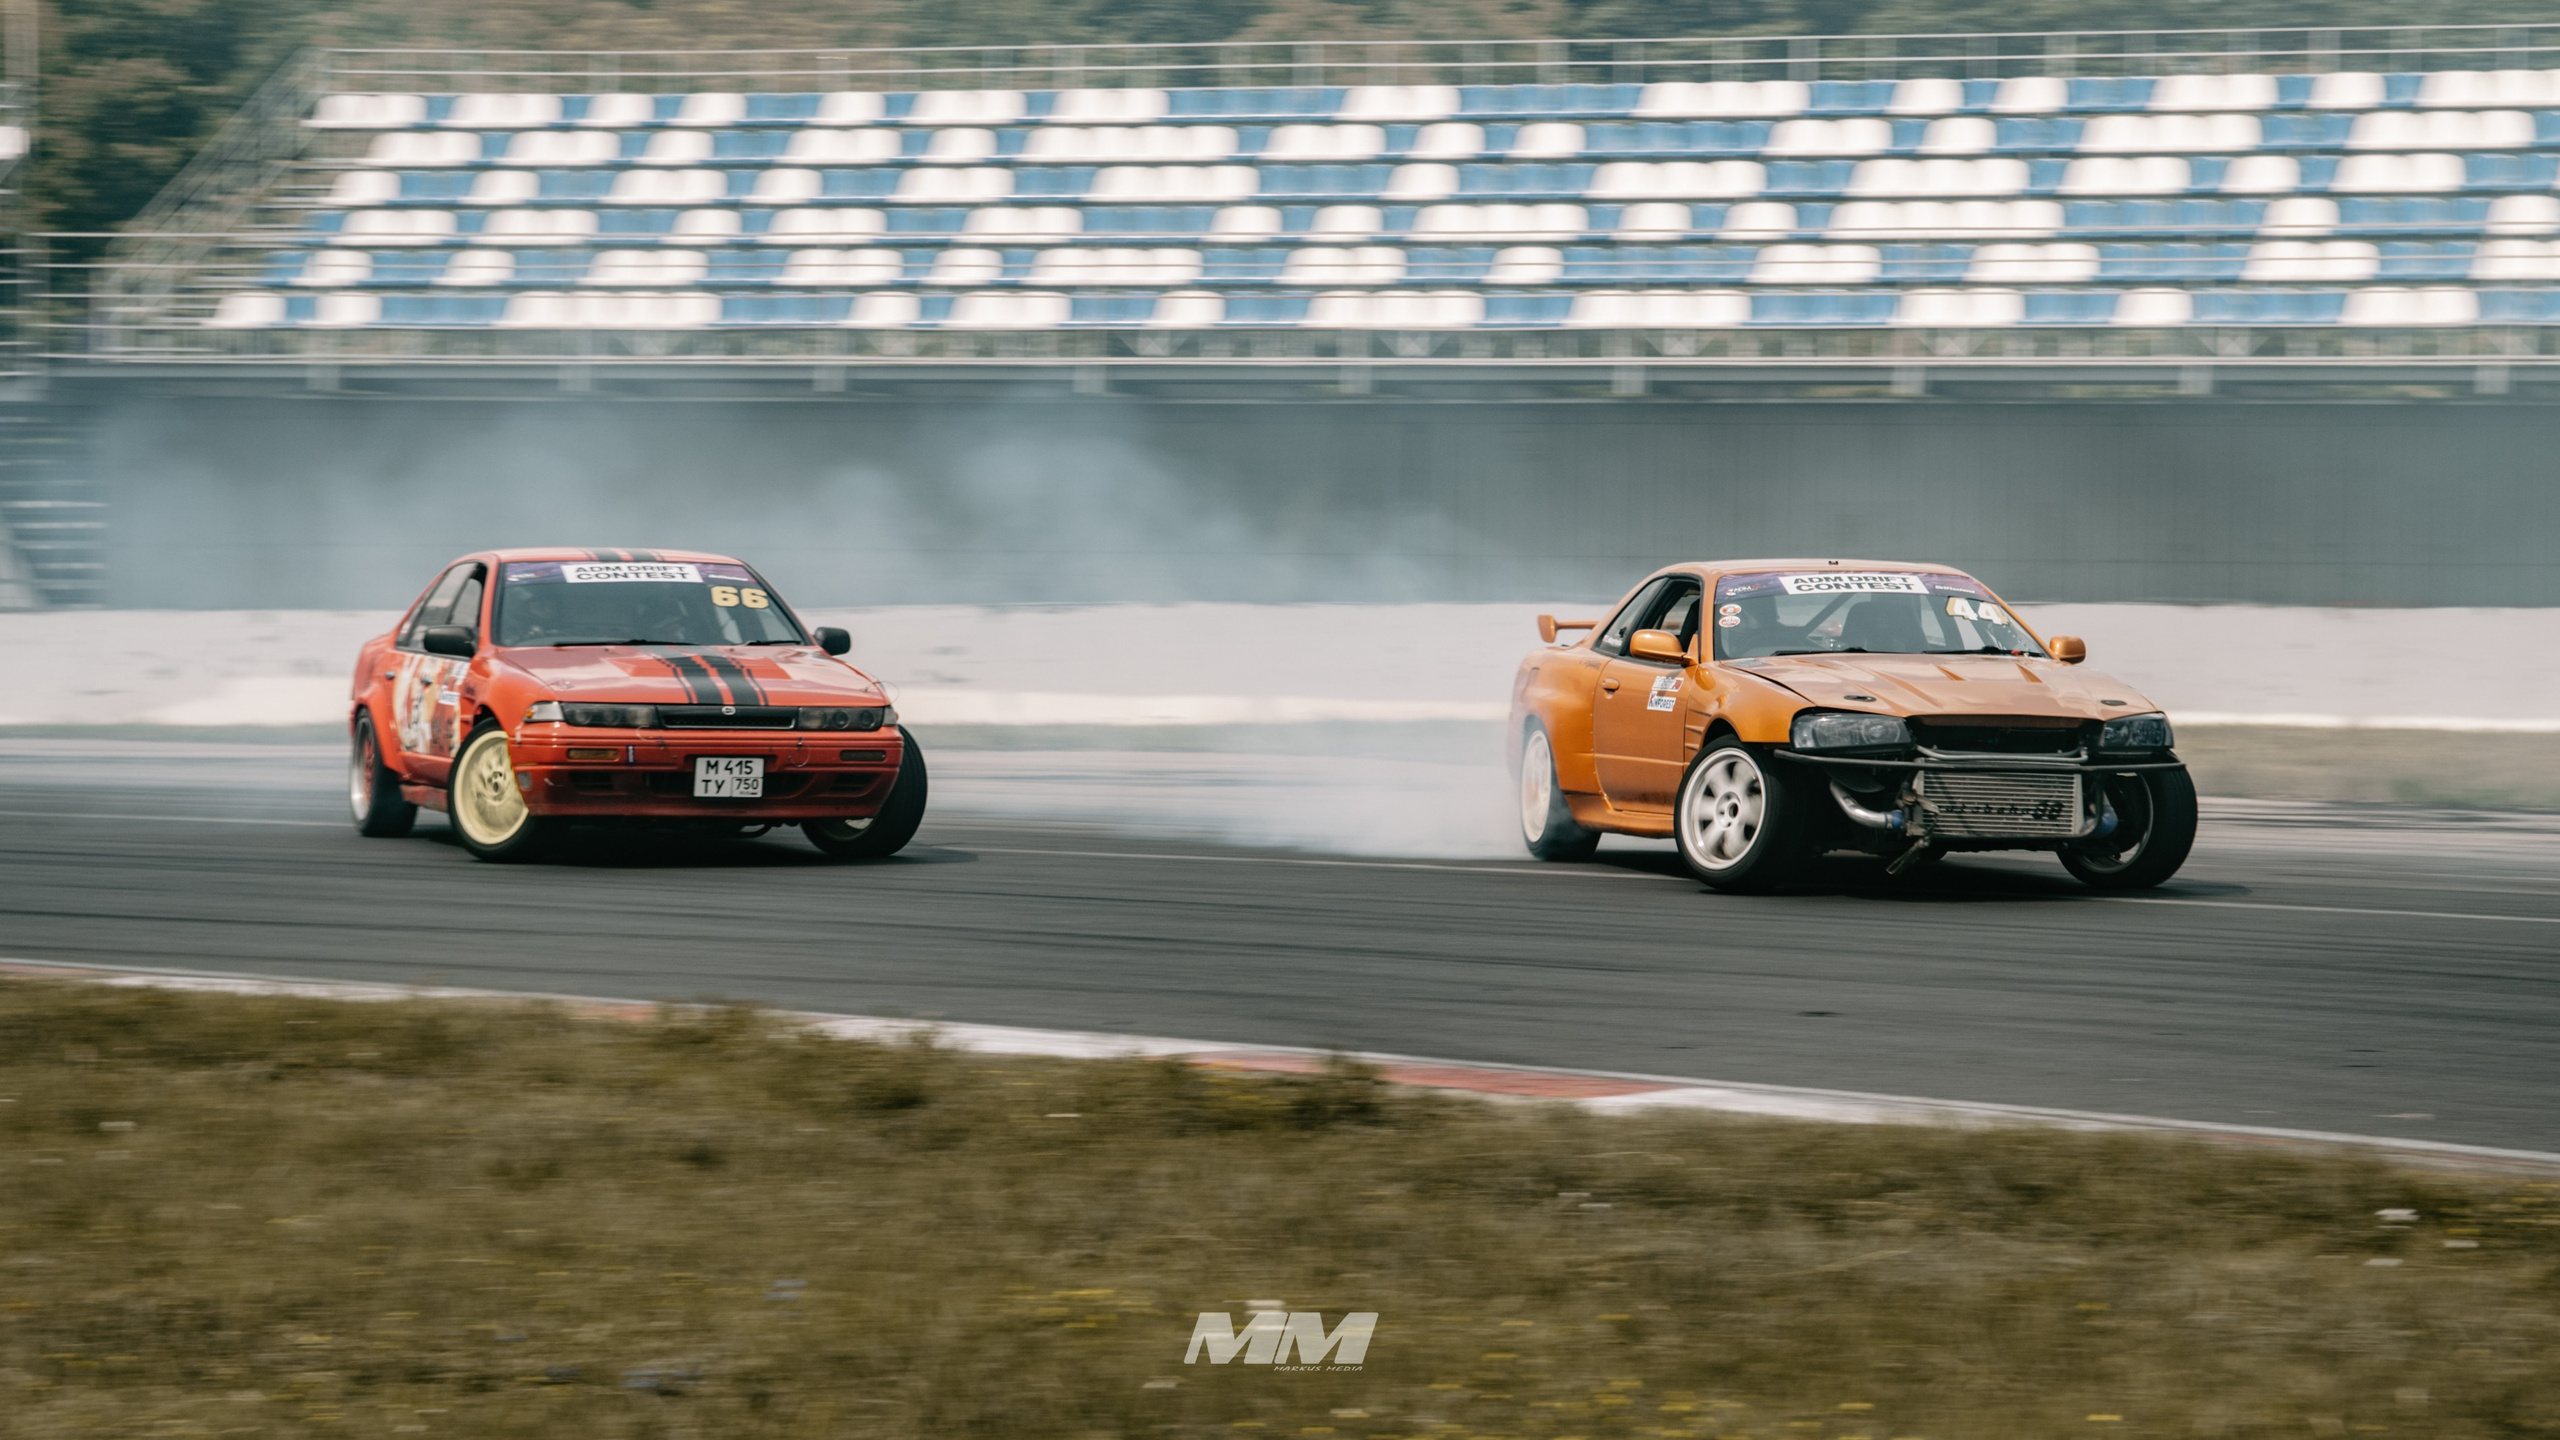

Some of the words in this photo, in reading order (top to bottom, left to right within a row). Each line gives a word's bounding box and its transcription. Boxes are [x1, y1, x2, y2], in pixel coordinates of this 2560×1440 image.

[577, 572, 690, 580] CONTEST
[1794, 576, 1844, 584] ADM
[1847, 575, 1910, 583] DRIFT
[1795, 582, 1914, 591] CONTEST
[710, 585, 770, 609] 66
[1946, 596, 2009, 625] 44
[724, 760, 753, 775] 415
[735, 778, 759, 790] 750
